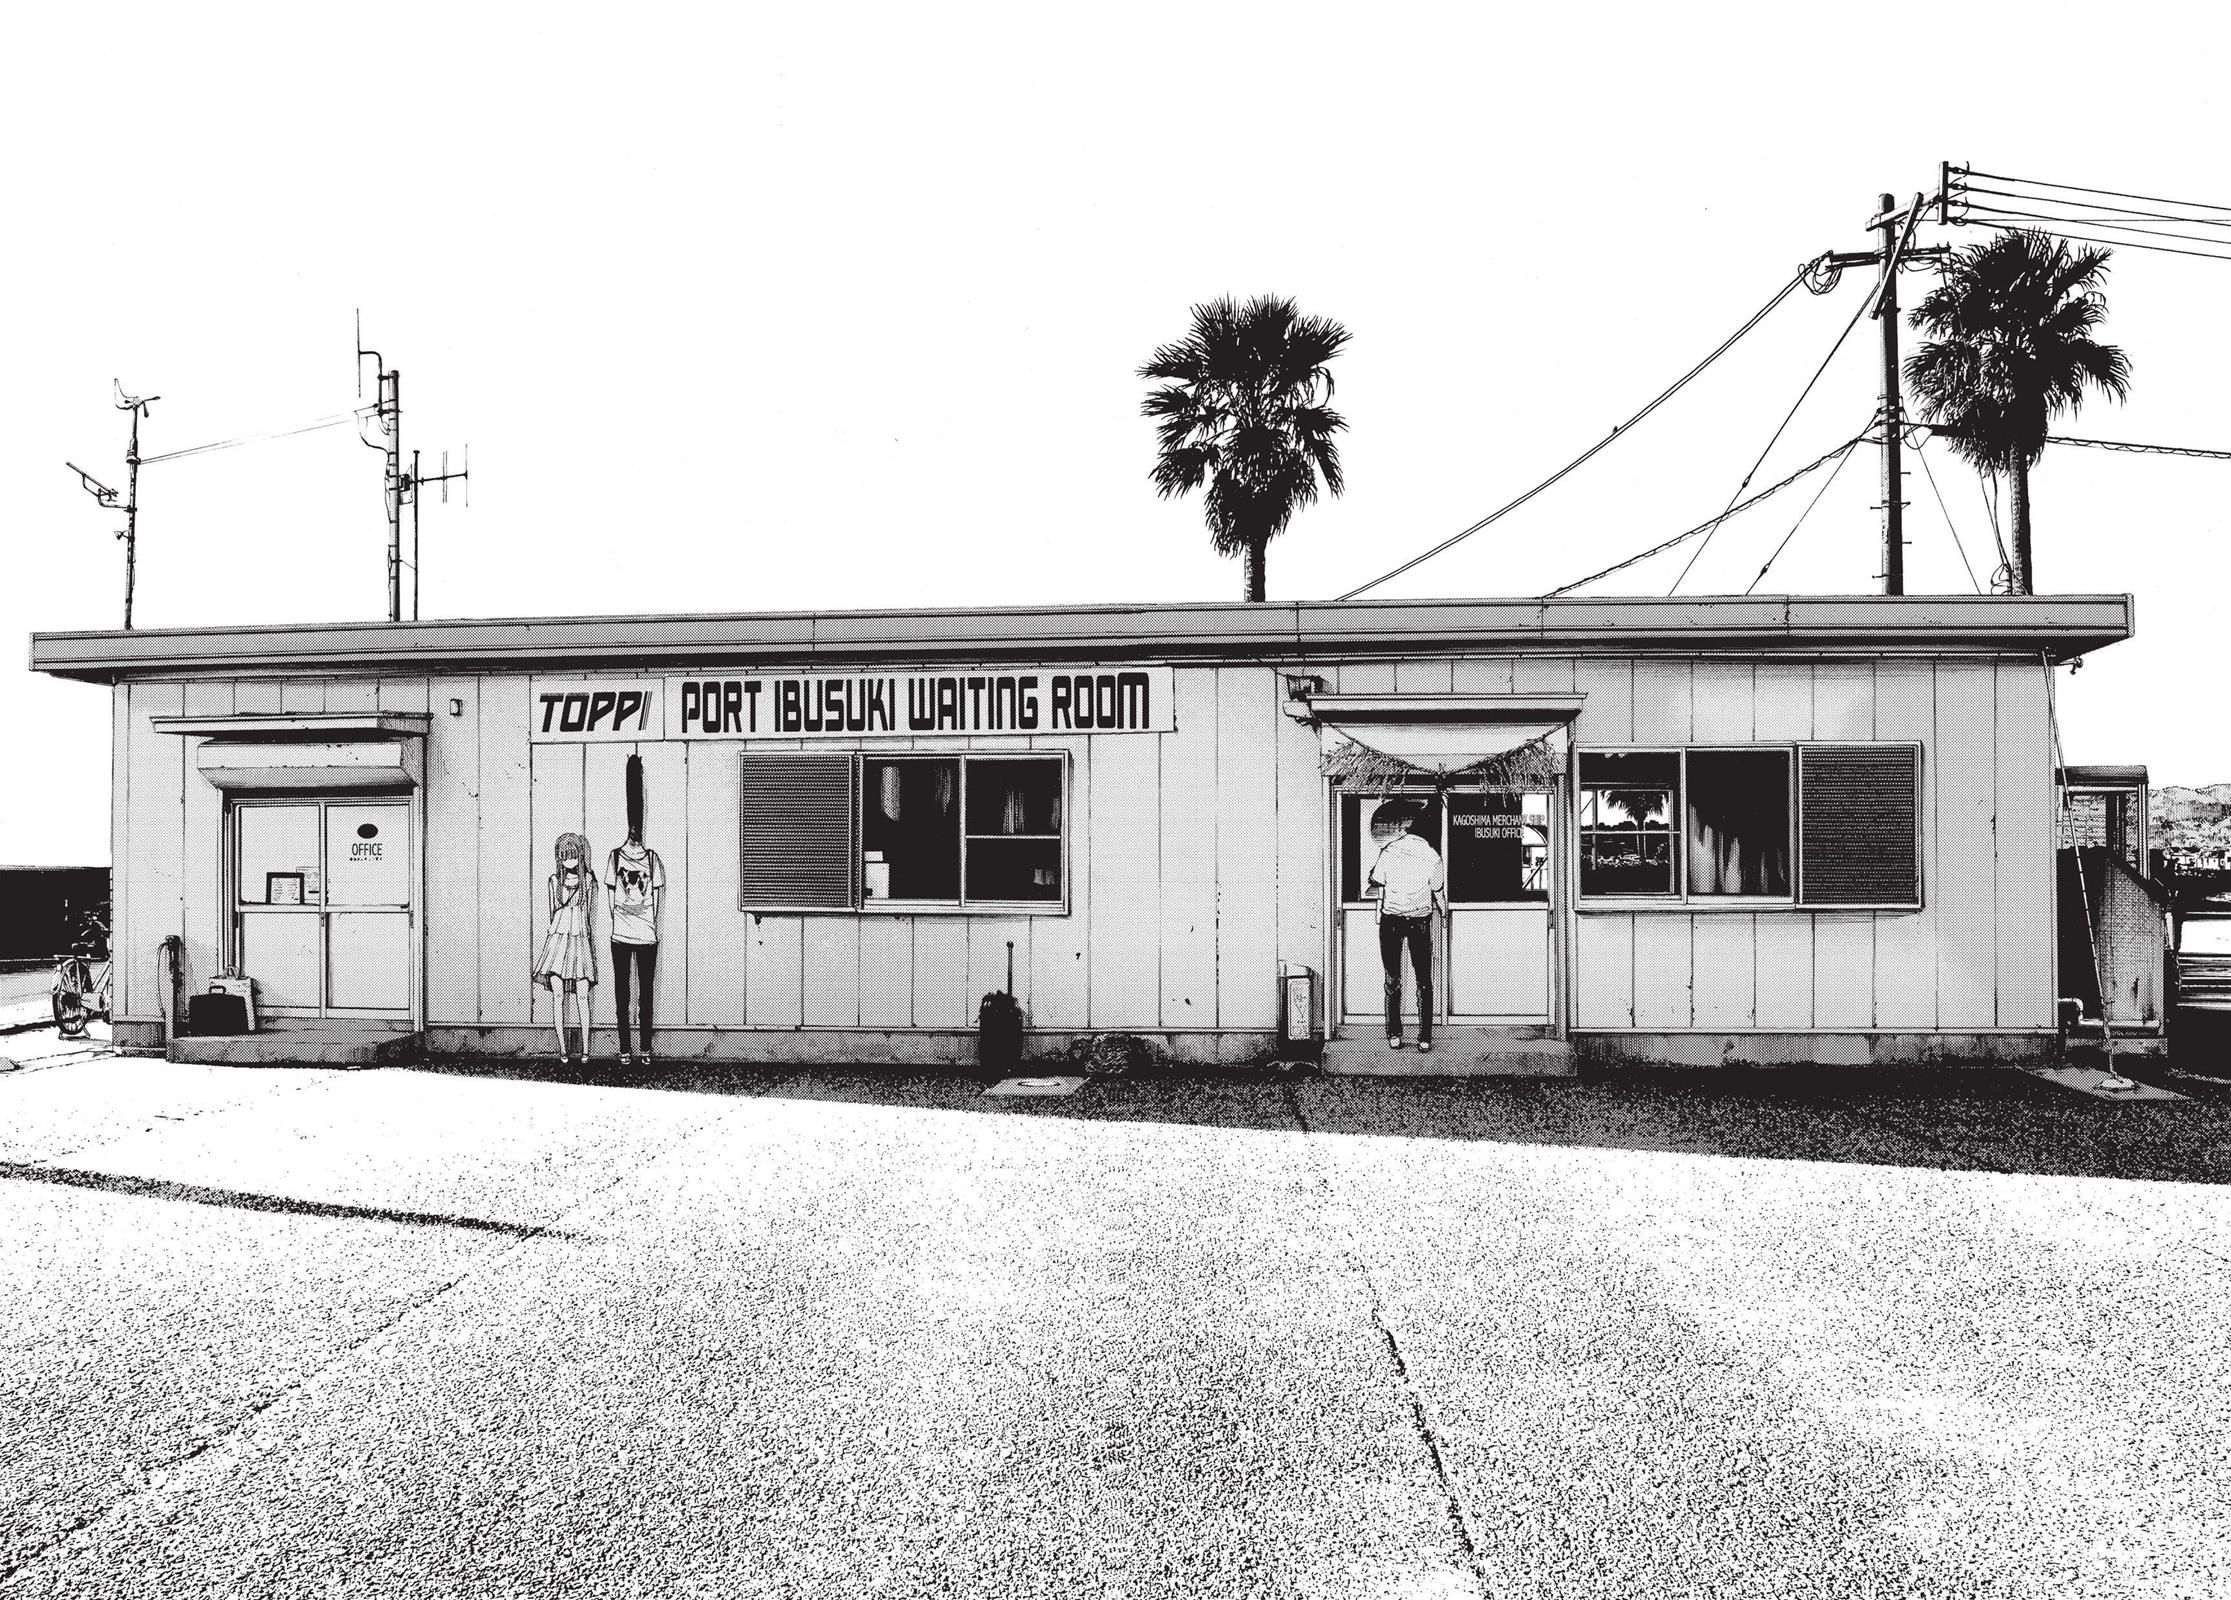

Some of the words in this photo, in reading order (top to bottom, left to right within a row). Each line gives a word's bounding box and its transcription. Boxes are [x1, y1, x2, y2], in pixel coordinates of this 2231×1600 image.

[682, 680, 762, 733] PORT
[774, 677, 896, 732] IBUSUKI
[908, 676, 1039, 731] WAITING
[1051, 672, 1150, 729] ROOM
[540, 691, 653, 733] TOPPI
[1453, 815, 1491, 826] KAGOSHIMA
[1475, 827, 1500, 838] IBUSUKI
[351, 843, 382, 856] OFFICE
